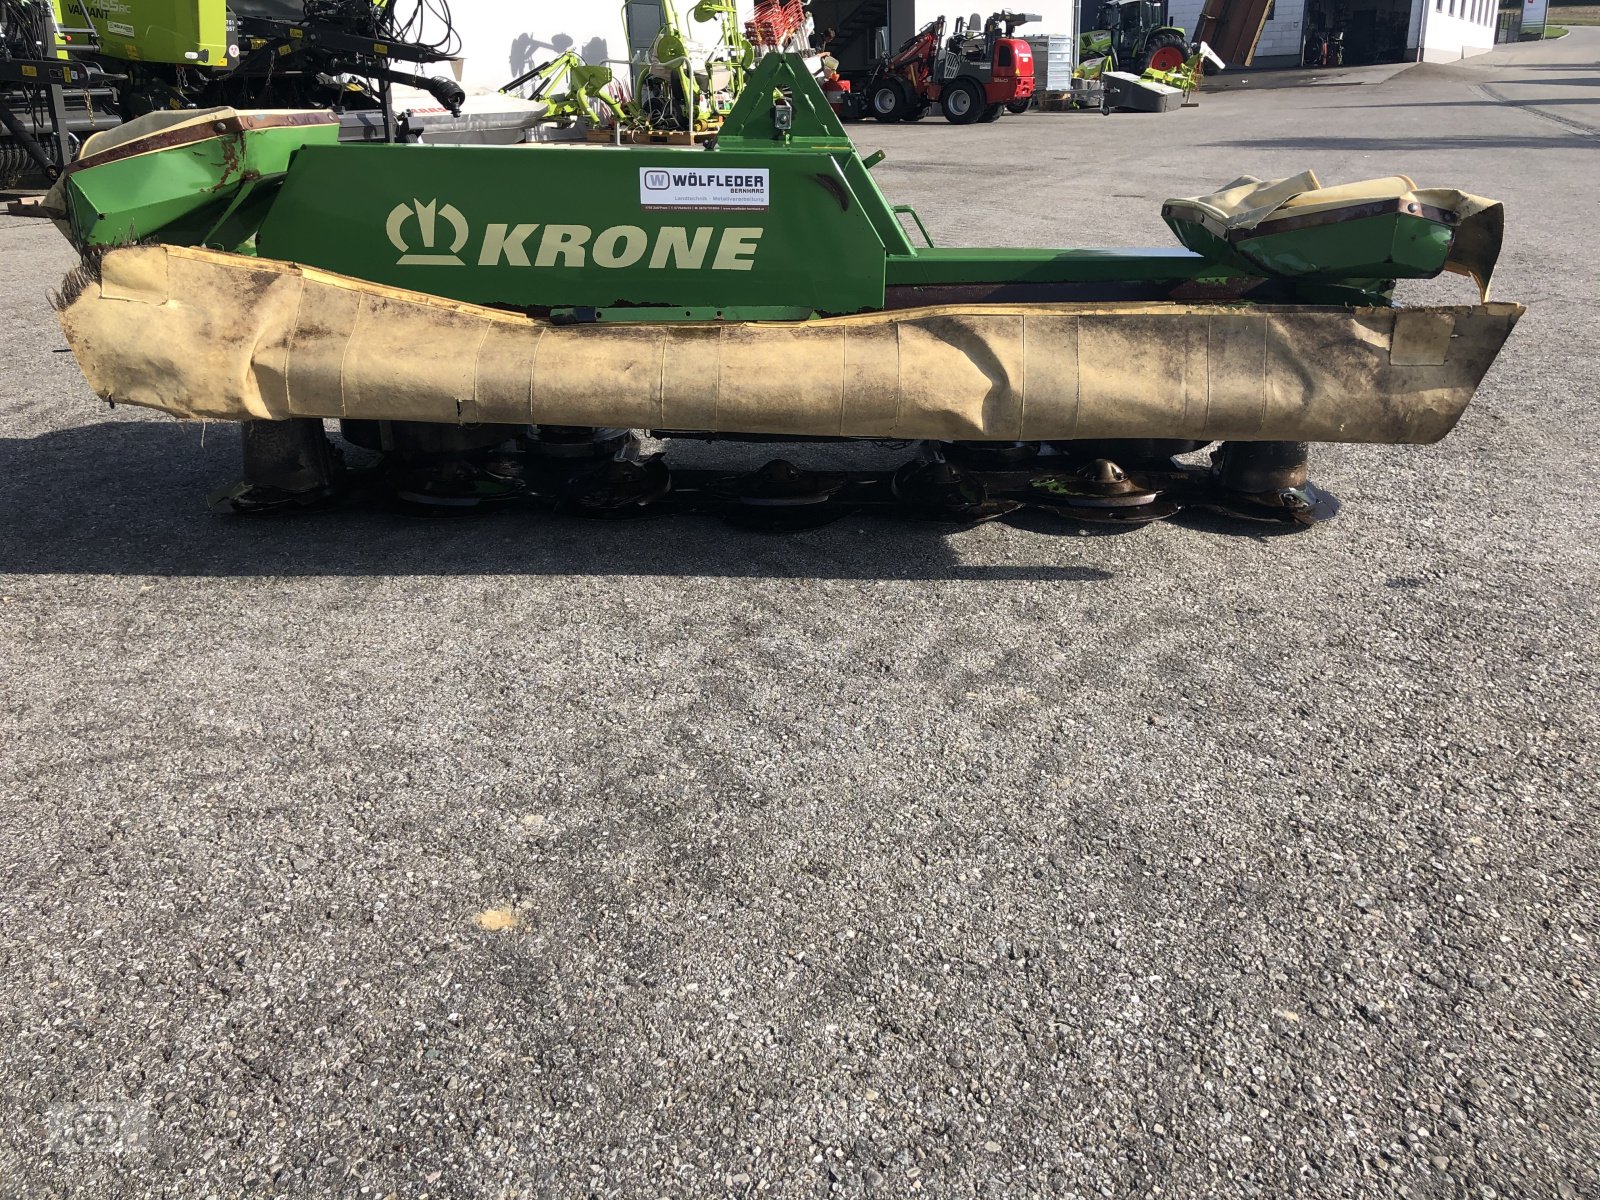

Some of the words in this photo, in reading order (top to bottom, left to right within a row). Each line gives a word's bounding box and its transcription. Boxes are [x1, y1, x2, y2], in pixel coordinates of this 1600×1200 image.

[650, 175, 664, 186] W
[673, 172, 764, 187] WÖLFLEDER
[477, 223, 764, 271] KRONE
